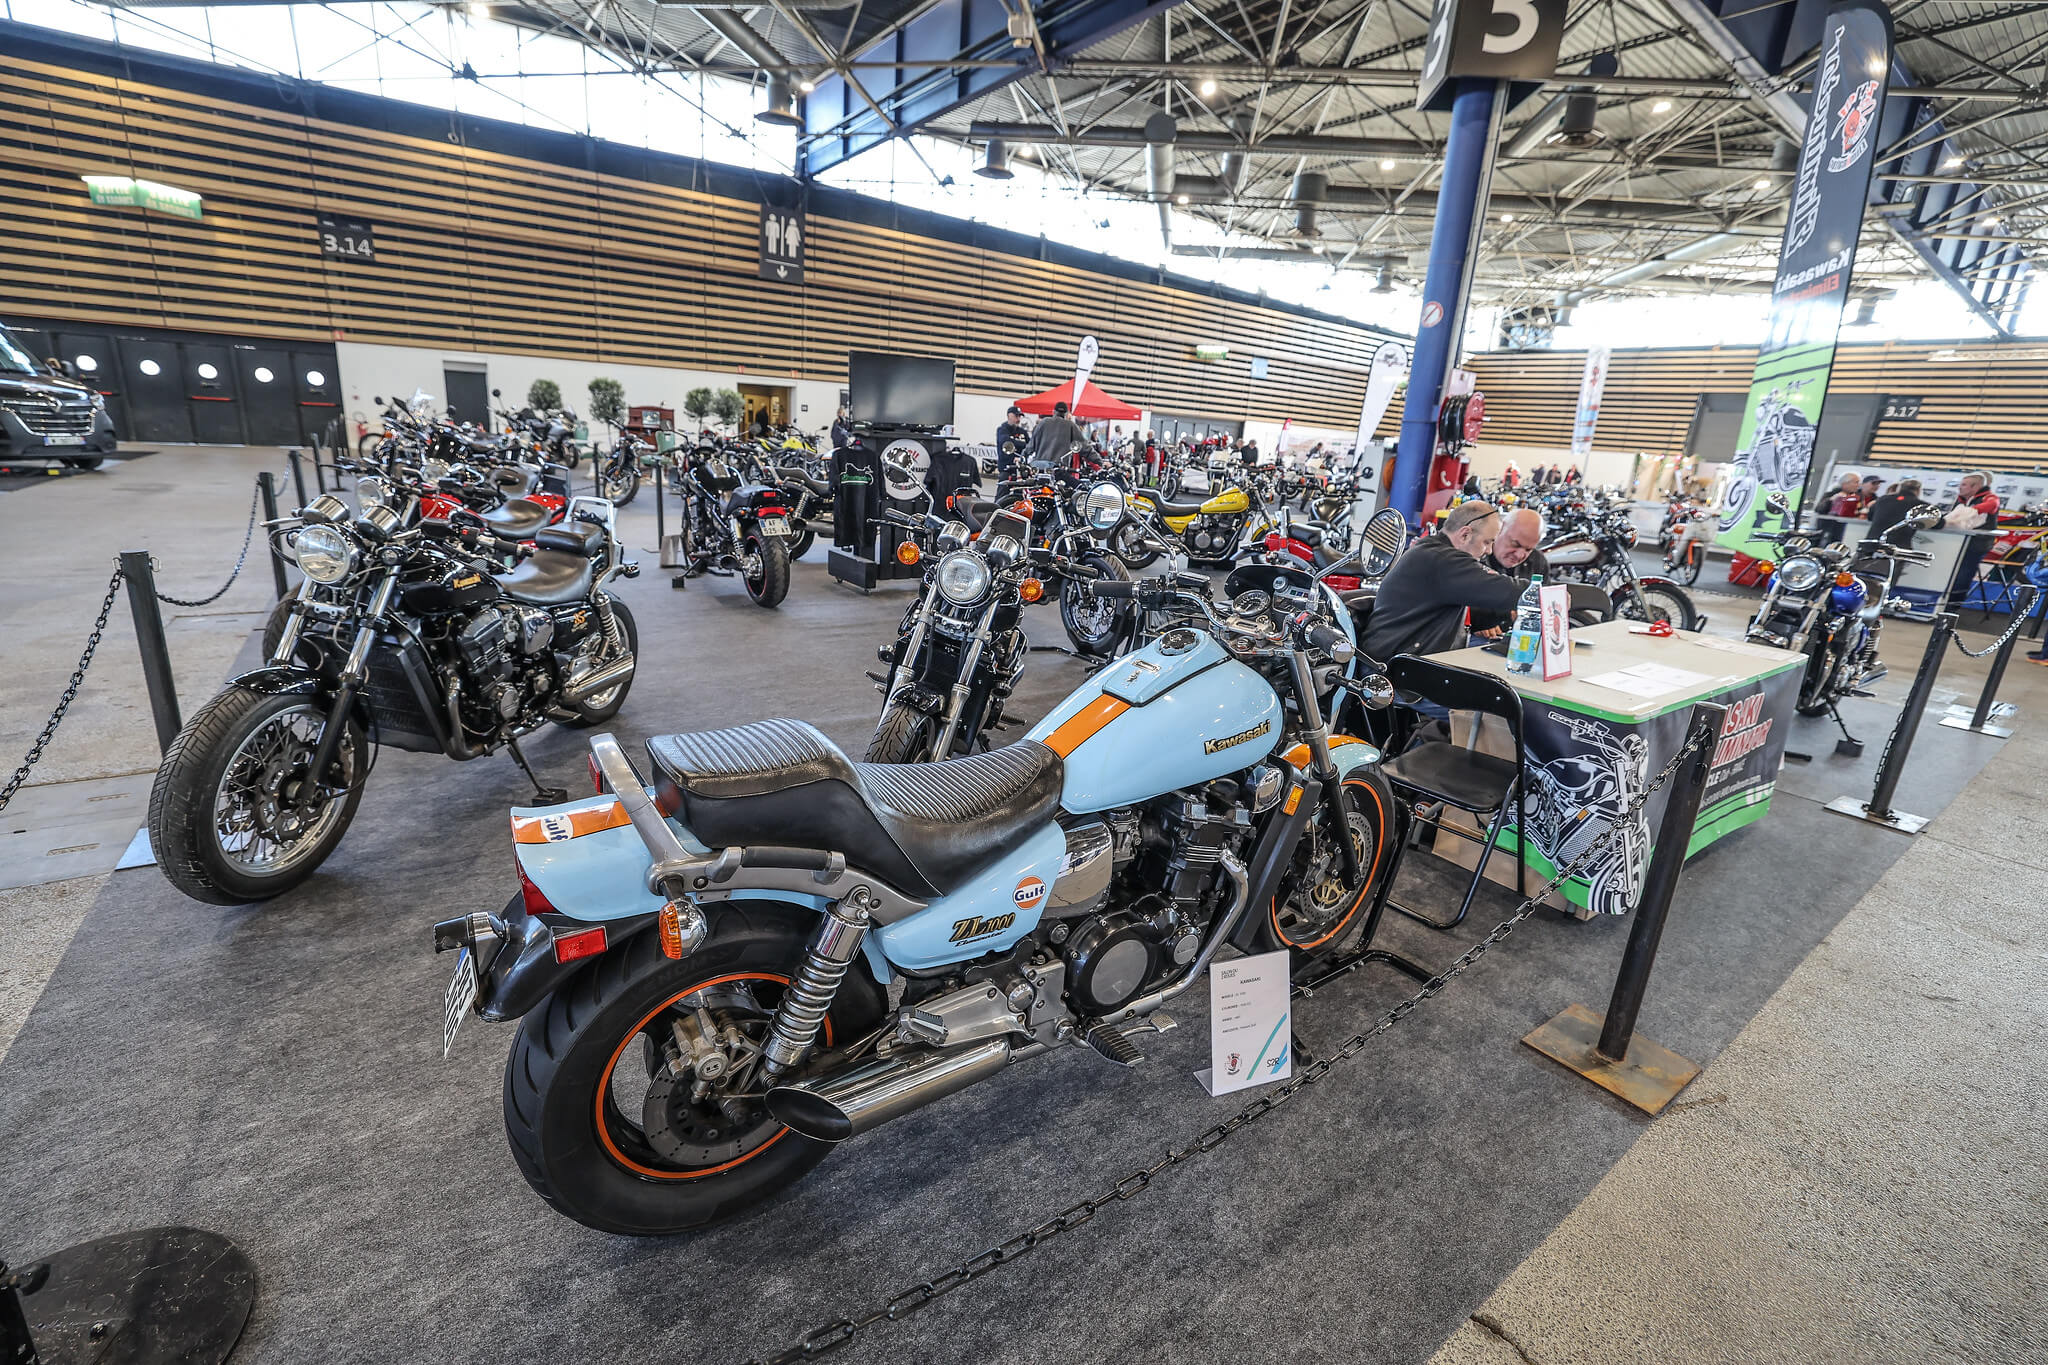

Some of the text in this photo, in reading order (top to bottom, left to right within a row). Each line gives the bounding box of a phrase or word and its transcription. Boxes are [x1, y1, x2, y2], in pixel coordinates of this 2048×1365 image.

[1482, 0, 1540, 54] 3
[323, 233, 373, 257] 3.14
[1884, 405, 1918, 417] 3.17
[1204, 719, 1271, 755] Kawasaki
[1014, 885, 1045, 902] Gulf
